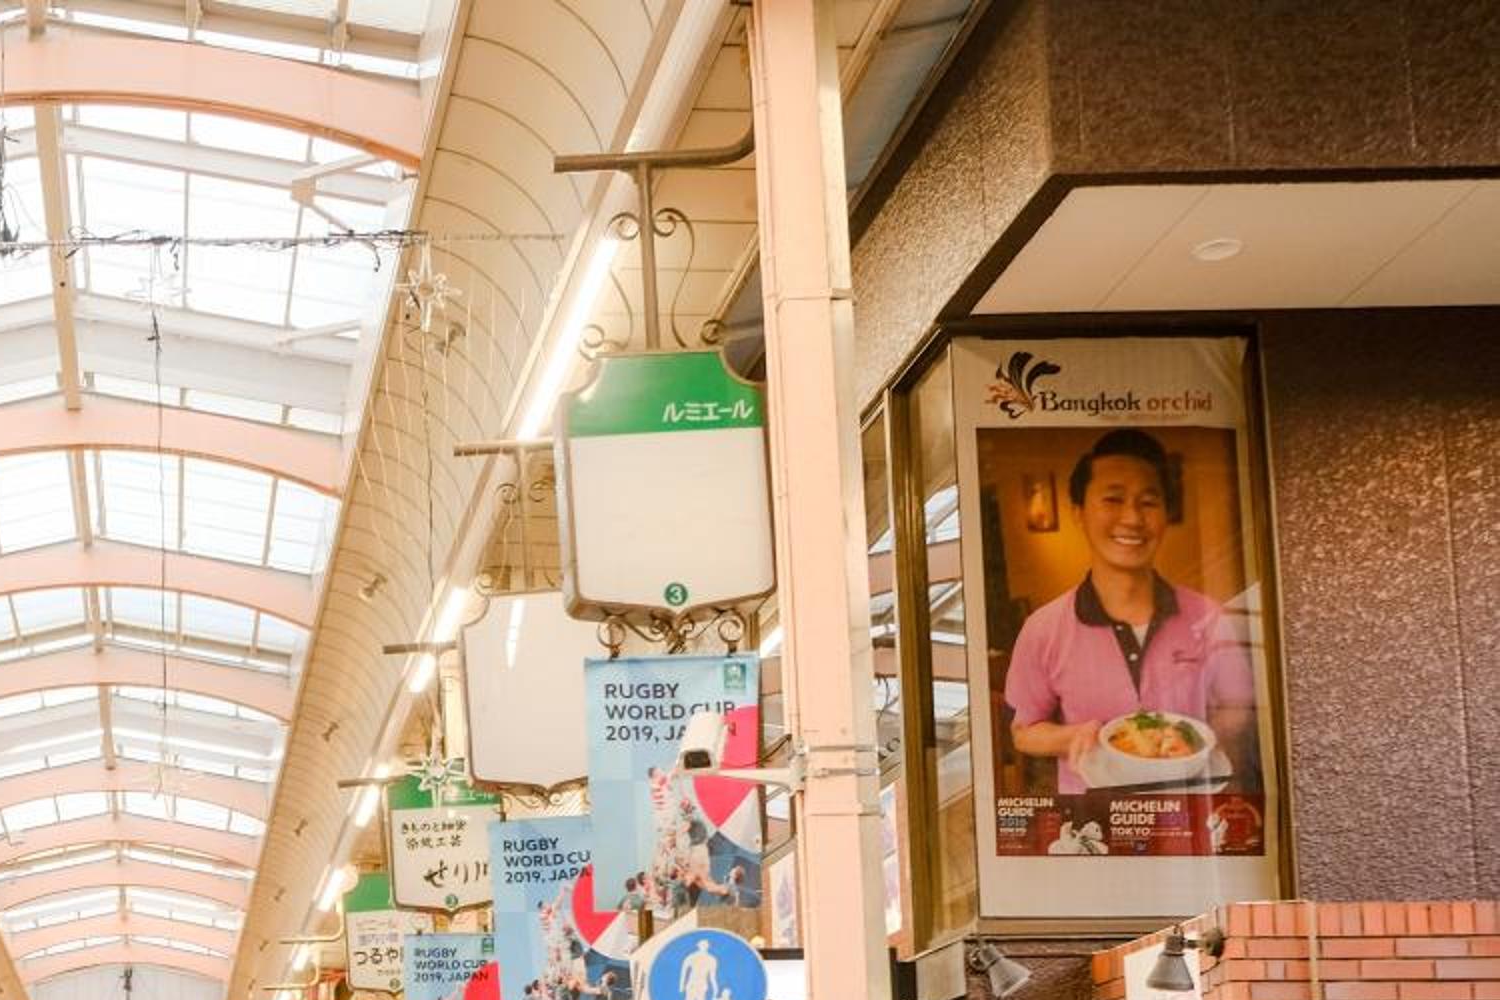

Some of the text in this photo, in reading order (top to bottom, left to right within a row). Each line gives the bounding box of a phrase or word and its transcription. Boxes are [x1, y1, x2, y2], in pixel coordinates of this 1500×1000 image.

[1041, 391, 1141, 414] Bangkok
[662, 400, 754, 423] ルミエール
[604, 683, 680, 699] RUGBY
[605, 703, 685, 721] WORLD
[606, 724, 660, 743] 2019,
[998, 798, 1053, 807] MICHELIN
[1110, 800, 1181, 813] MICHELIN
[998, 808, 1035, 817] GUIDE
[1110, 813, 1156, 825] GUIDE
[1110, 827, 1151, 836] TOKYO
[503, 837, 559, 852] RUGBY
[503, 849, 592, 868] WORLD CU
[504, 866, 592, 883] 2019, JAPA
[353, 947, 404, 965] つるや
[414, 948, 457, 958] RUGBY
[414, 959, 461, 970] WORLD
[447, 972, 489, 982] JAPAN
